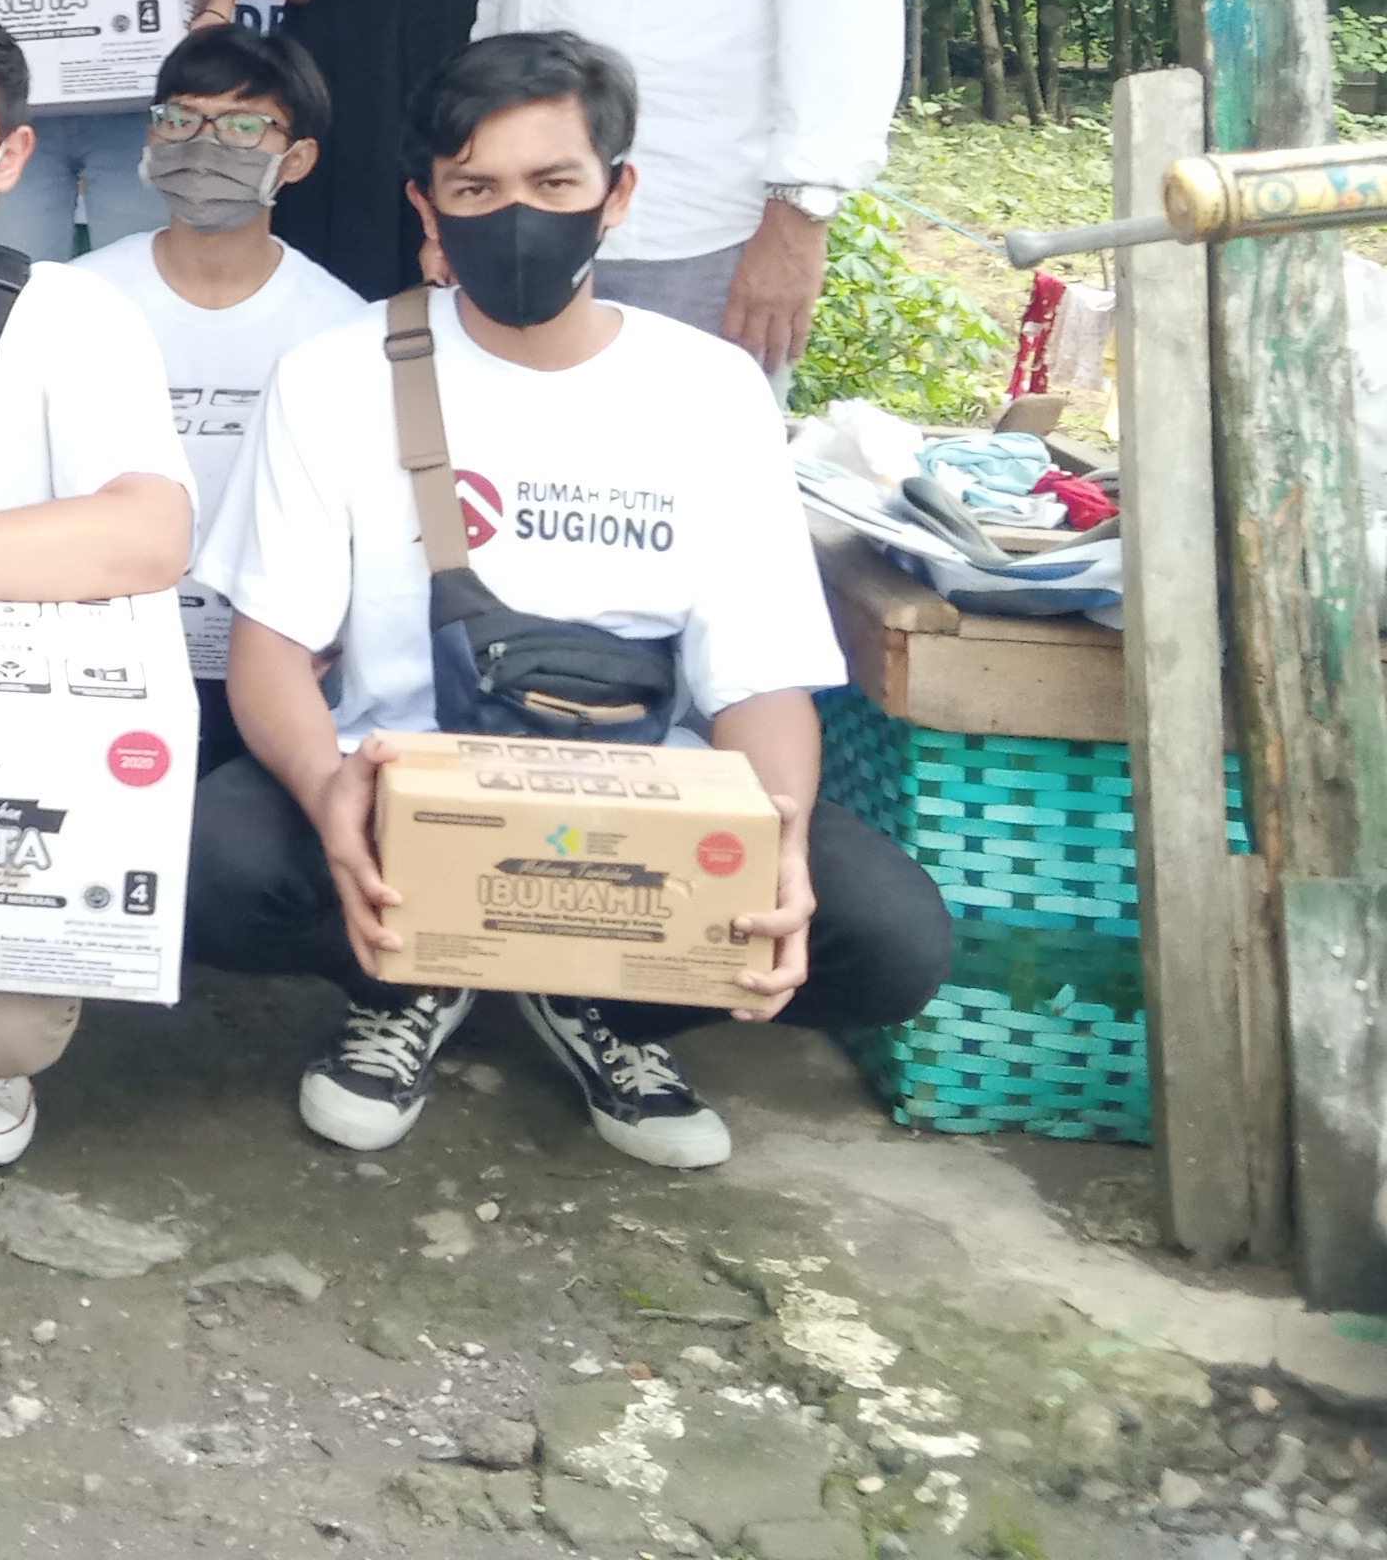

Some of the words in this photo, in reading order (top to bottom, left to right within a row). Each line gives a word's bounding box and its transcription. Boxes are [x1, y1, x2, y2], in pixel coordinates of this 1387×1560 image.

[517, 481, 599, 503] RUMAH
[609, 488, 674, 514] PUTIH
[515, 508, 674, 552] SUGIONO
[120, 756, 155, 770] 2020
[130, 883, 148, 903] 4
[477, 874, 542, 908] IBU
[550, 879, 672, 919] HAMIL
